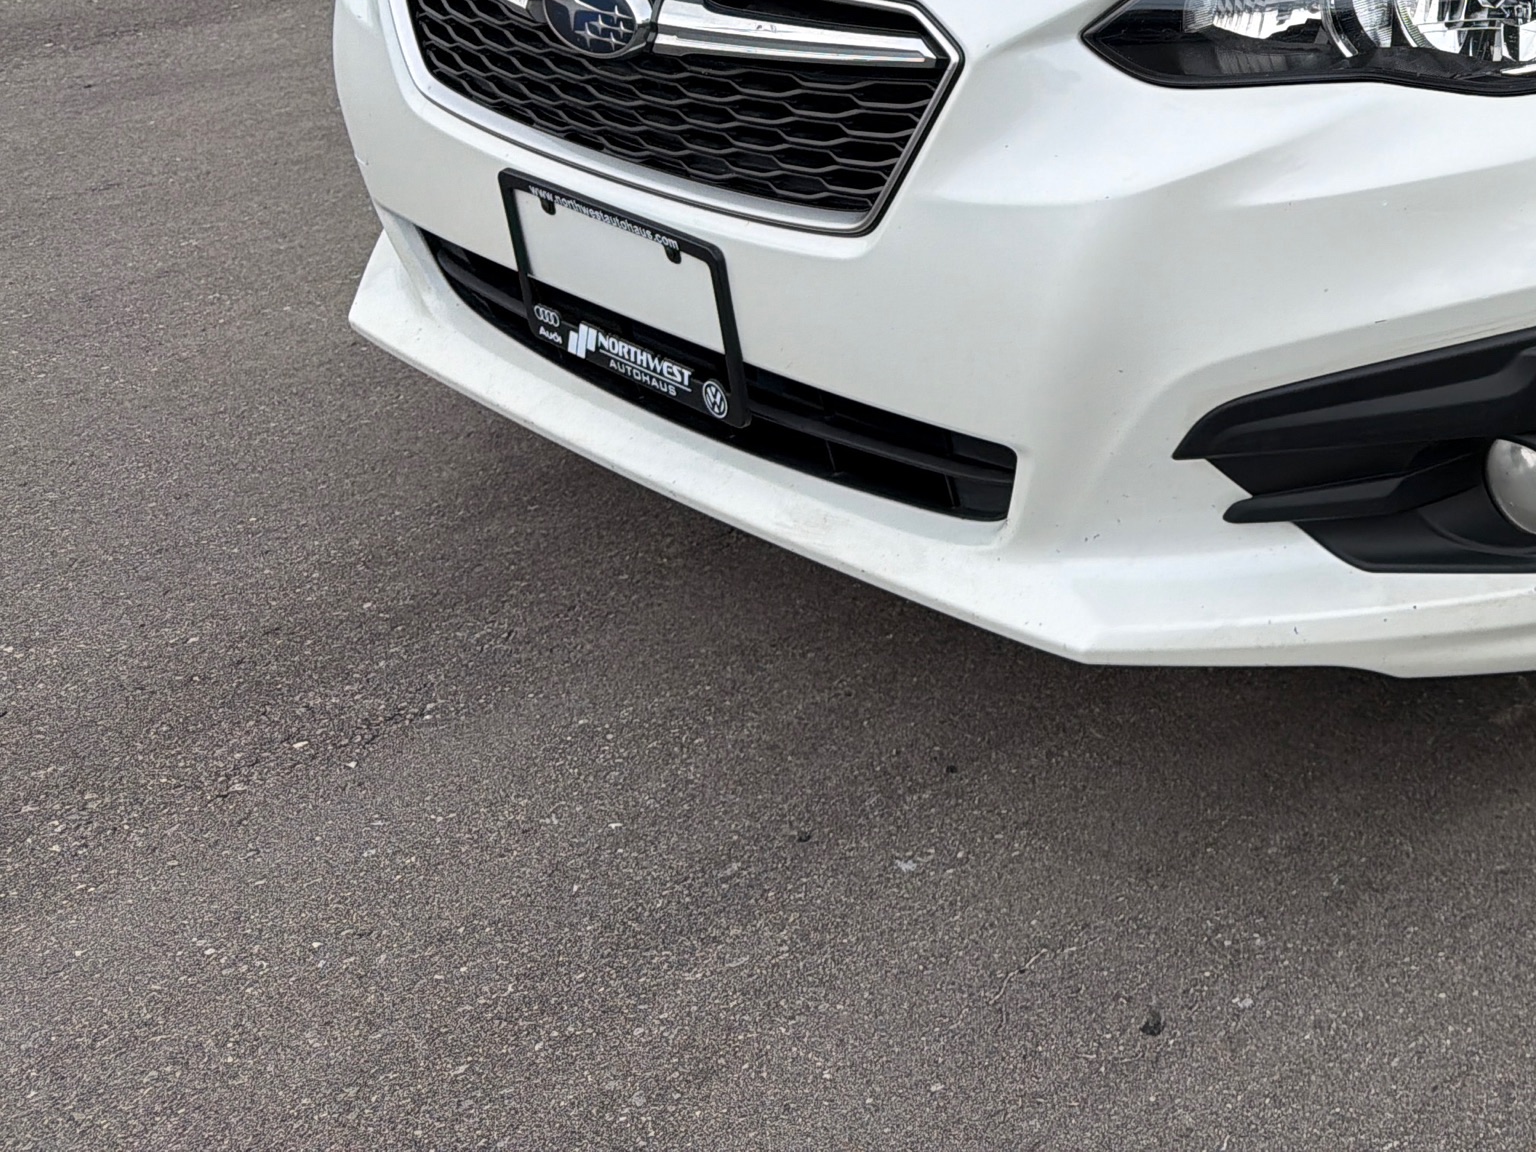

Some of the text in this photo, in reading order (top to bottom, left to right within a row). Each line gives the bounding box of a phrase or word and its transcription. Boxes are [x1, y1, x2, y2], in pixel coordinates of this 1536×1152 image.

[529, 185, 680, 250] www.northwestautohaus.com
[539, 325, 563, 345] Audi
[597, 331, 693, 387] NORTHWEST
[608, 358, 678, 397] AUTOHAUS
